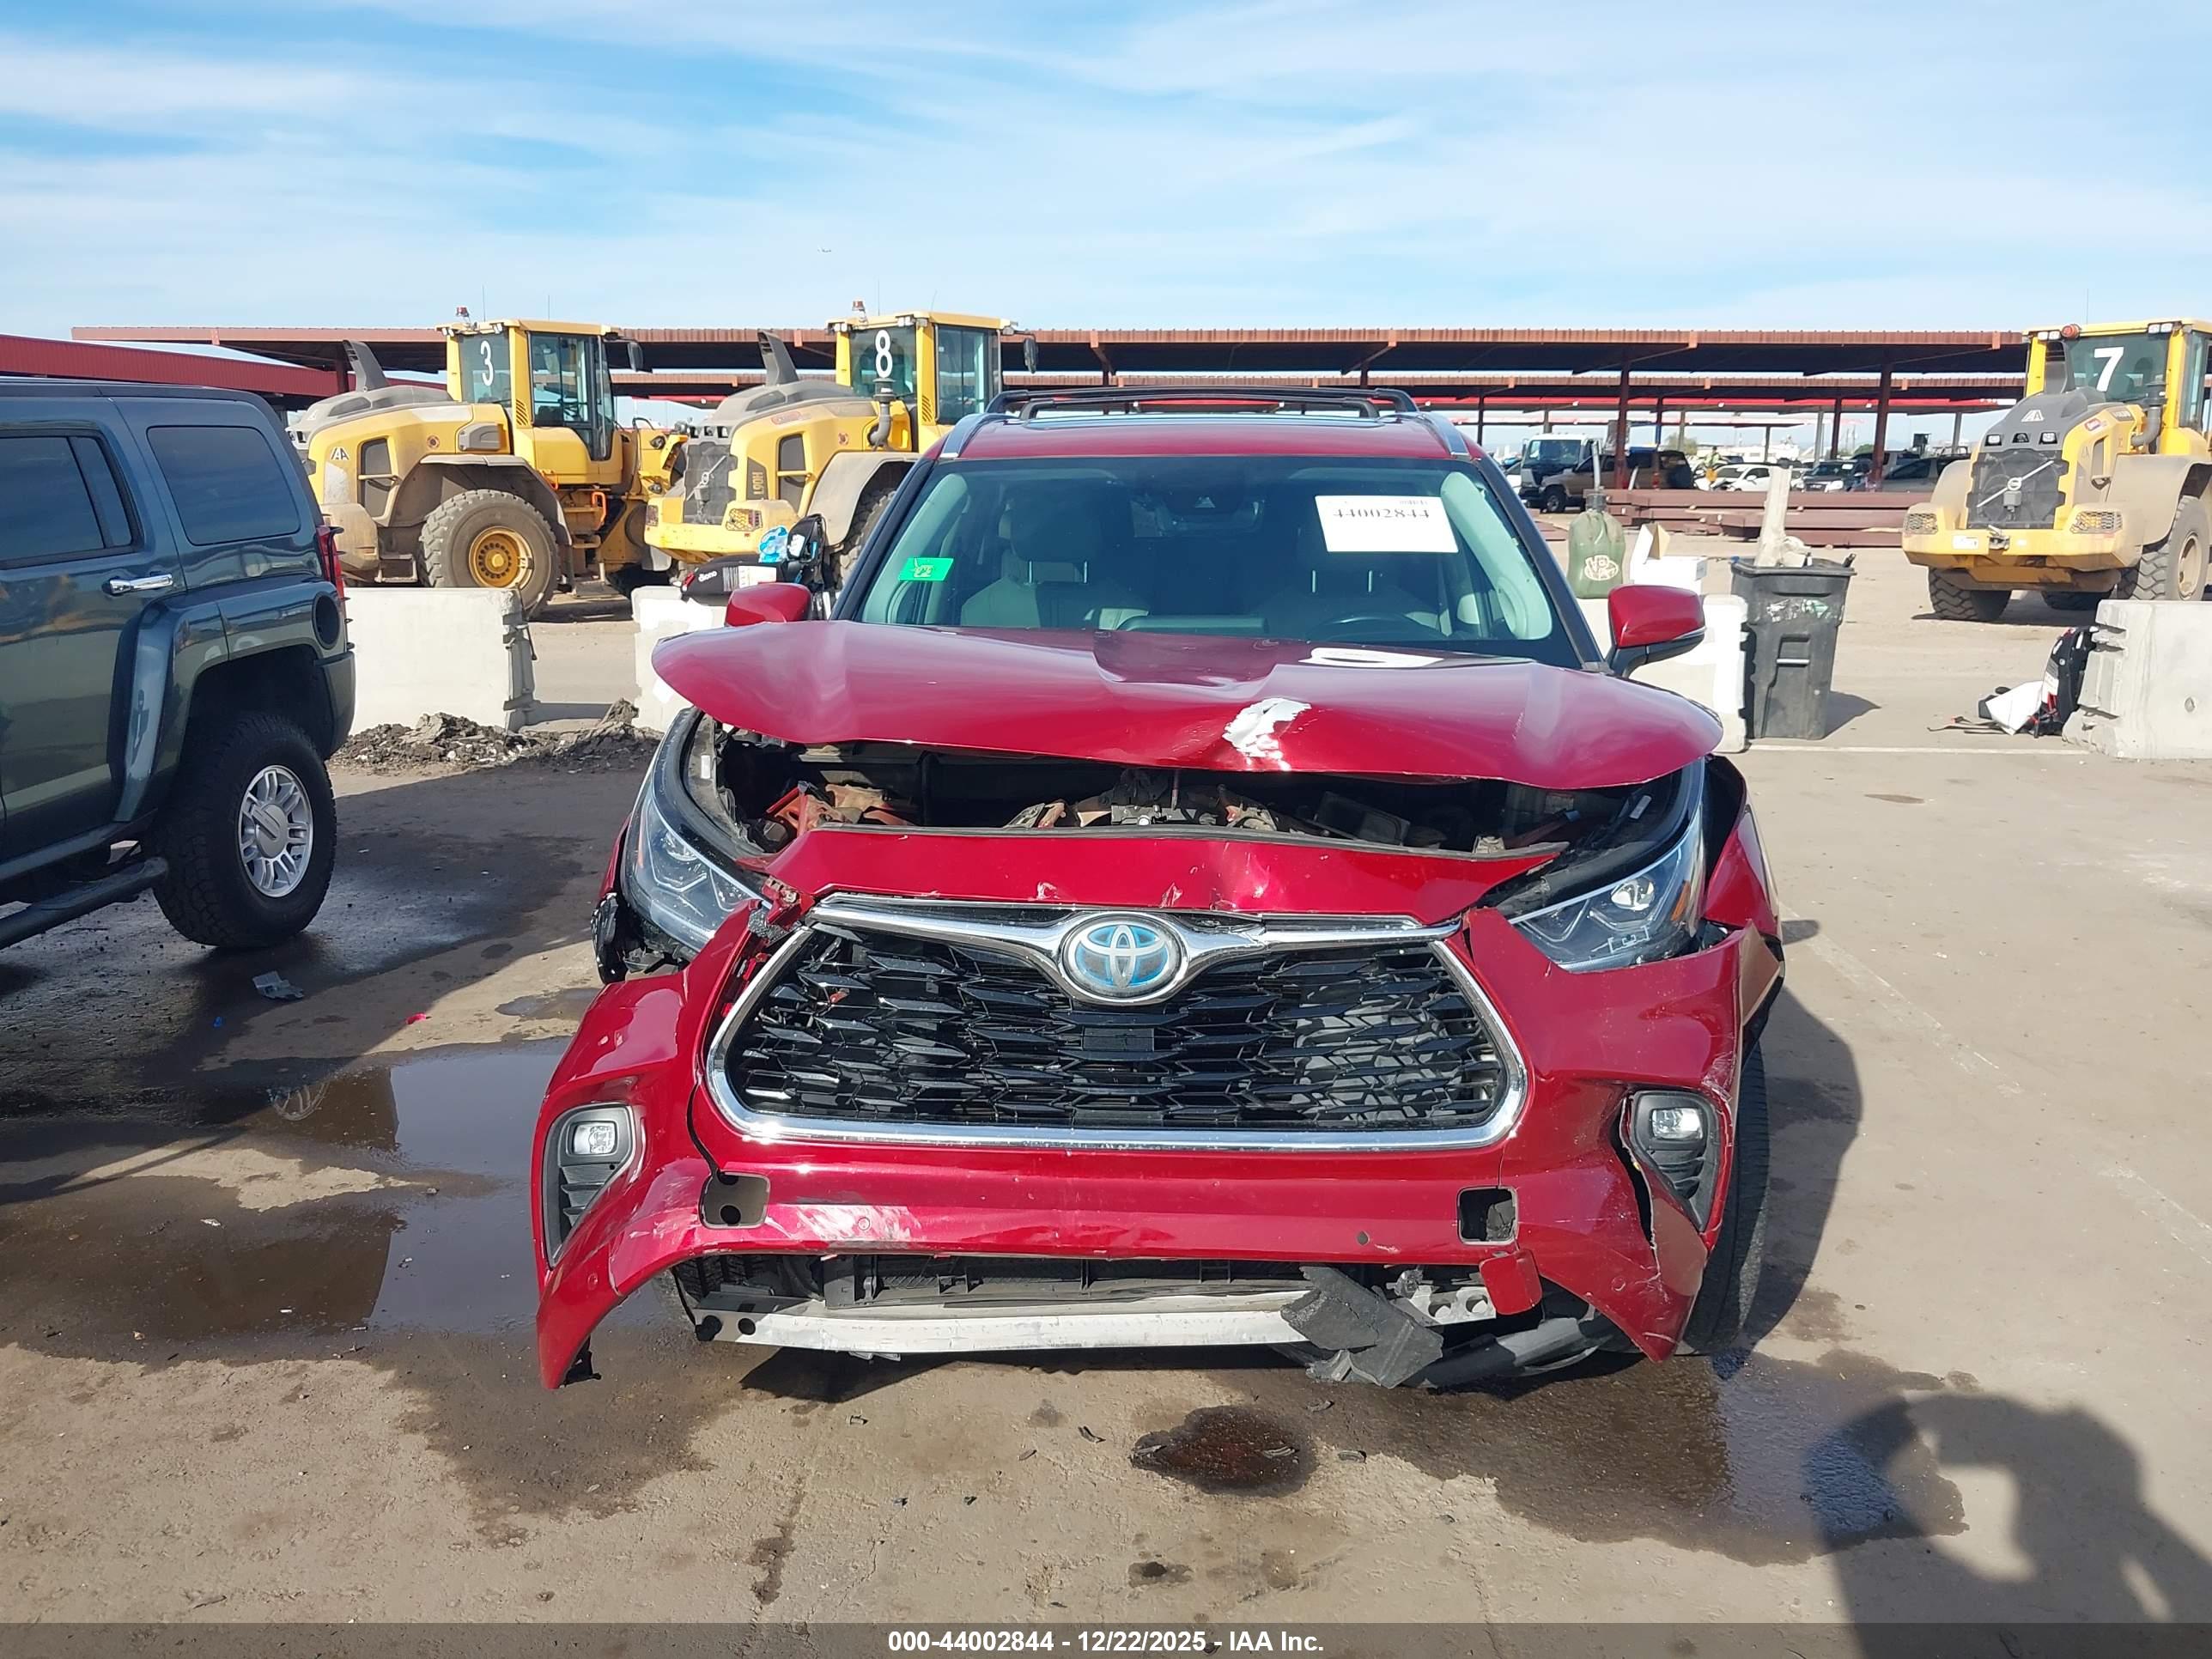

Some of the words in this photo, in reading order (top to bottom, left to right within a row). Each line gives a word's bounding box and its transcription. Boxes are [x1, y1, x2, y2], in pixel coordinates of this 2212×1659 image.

[480, 340, 494, 386] 3
[875, 330, 893, 379] 8
[2094, 346, 2124, 392] 7
[1333, 508, 1430, 519] 44002844
